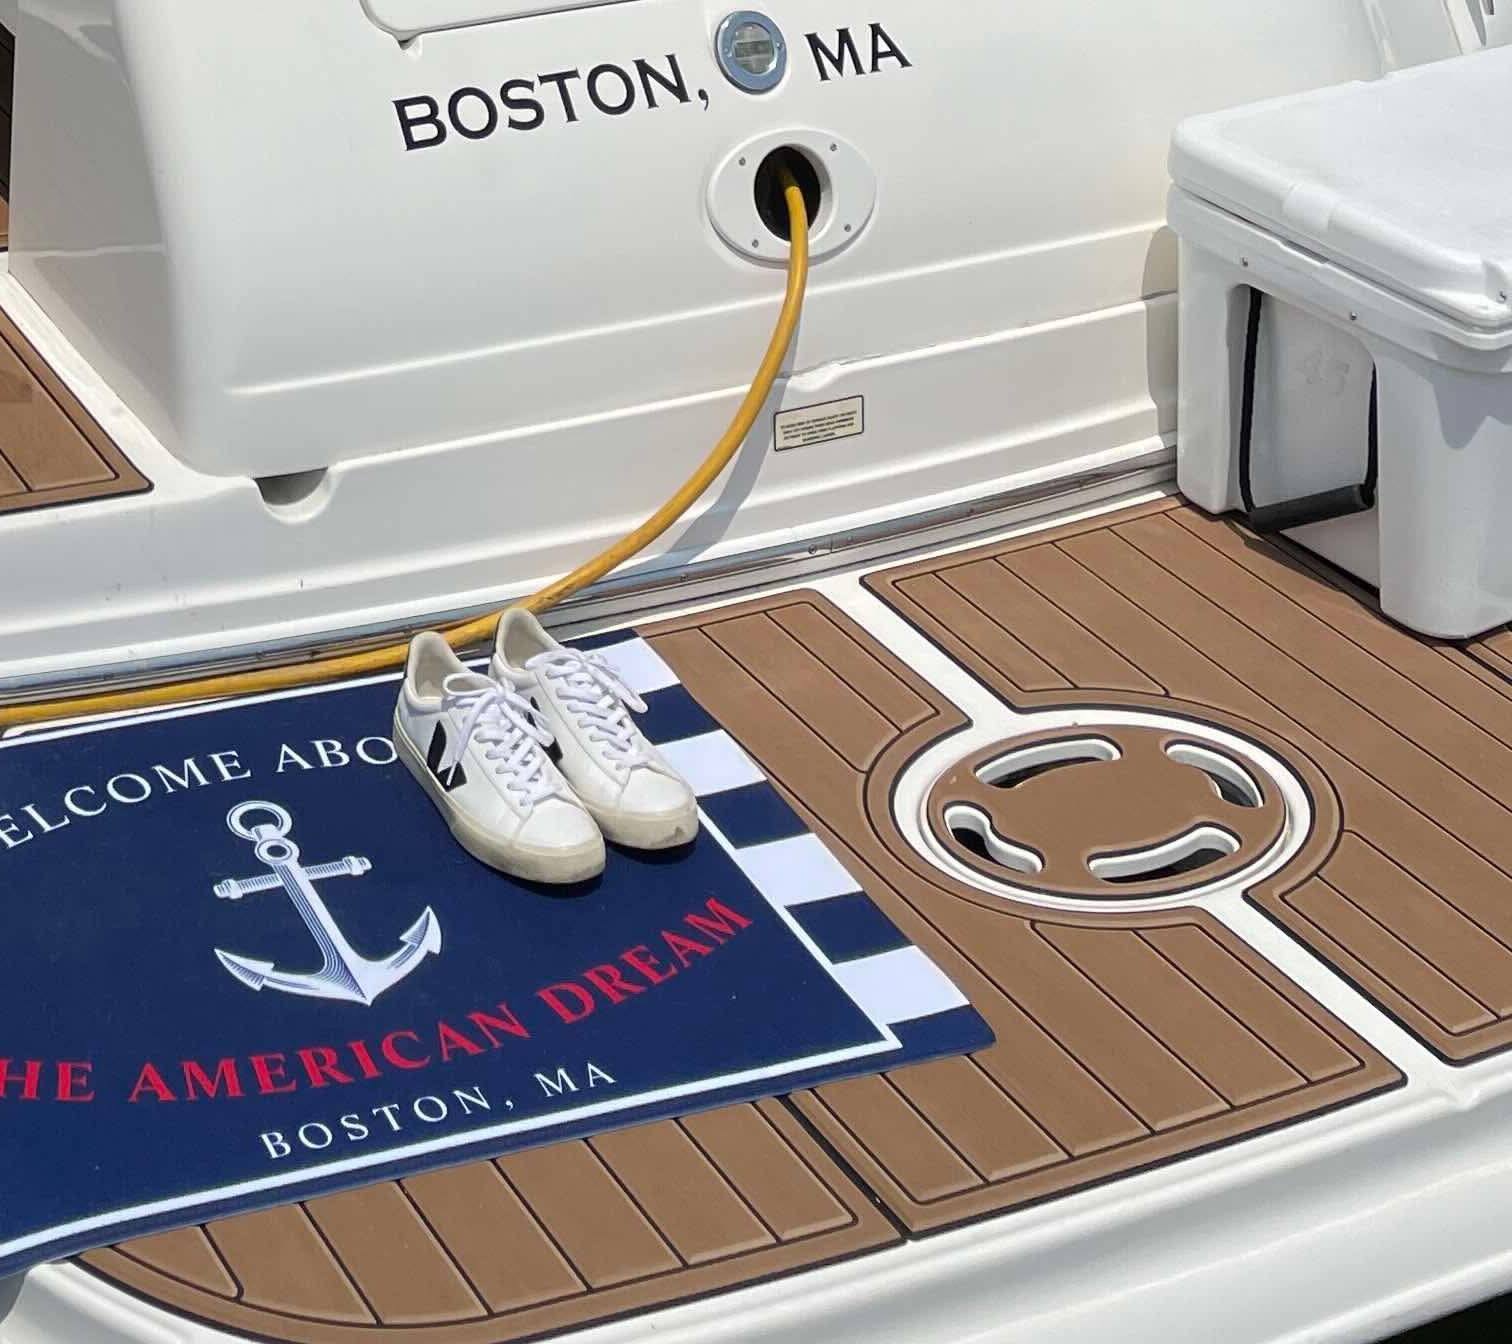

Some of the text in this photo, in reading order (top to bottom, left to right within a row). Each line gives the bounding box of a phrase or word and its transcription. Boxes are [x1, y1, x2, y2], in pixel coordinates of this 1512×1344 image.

[391, 23, 912, 151] BOSTON, MA
[276, 736, 399, 773] ABO
[126, 1002, 532, 1104] AMERICAN
[536, 895, 754, 1026] DREAM
[258, 1059, 619, 1161] BOSTON, MA
